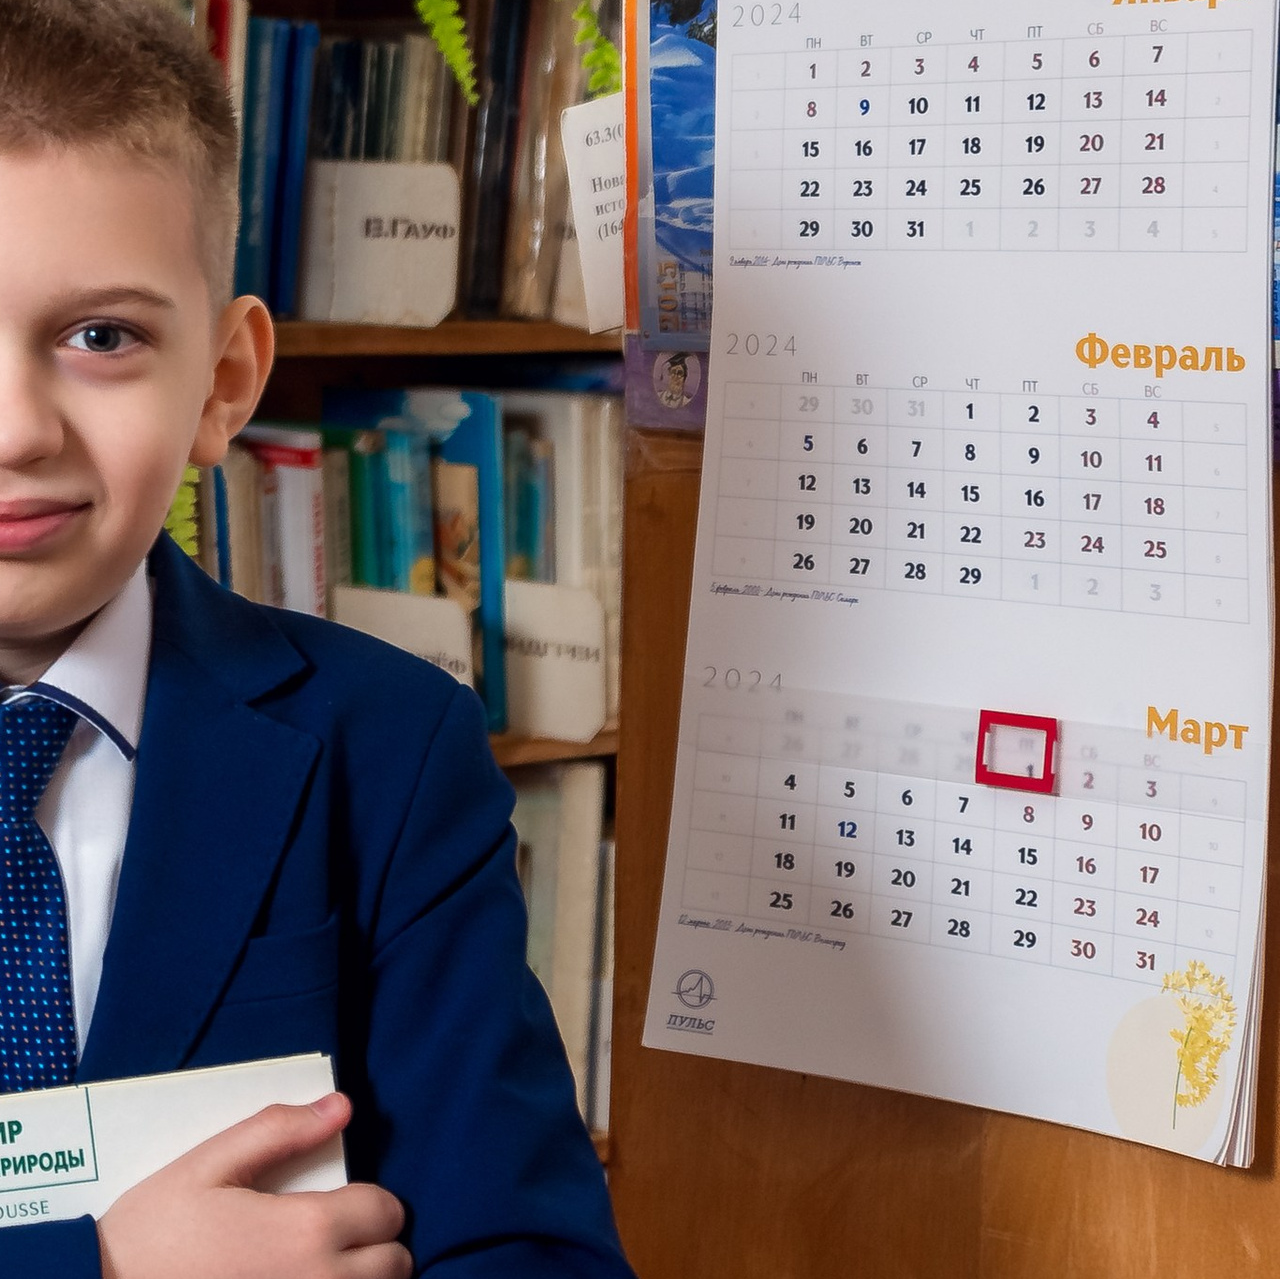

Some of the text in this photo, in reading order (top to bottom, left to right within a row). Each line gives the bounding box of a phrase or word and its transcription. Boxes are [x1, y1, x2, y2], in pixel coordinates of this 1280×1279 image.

[731, 2, 804, 28] 2024
[805, 18, 1168, 49] ПН ВТ СР ЧТ ПТ СБ ВС
[809, 45, 1164, 80] 1 2 3 4 5 6 7
[806, 89, 1168, 118] 8 9 10 11 12 13 14
[802, 132, 1165, 158] 15 16 17 18 19 20 21
[800, 176, 1166, 198] 22 23 24 25 26 27 28
[799, 220, 925, 238] 29 30 31
[657, 261, 681, 334] 2015
[726, 332, 798, 357] 2024
[1075, 332, 1247, 378] Февраль
[965, 402, 1160, 429] 1 2 3 4
[802, 434, 1163, 472] 5 6 7 8 9 10 11
[798, 474, 1166, 516] 12 13 14 15 16 17 18
[796, 513, 1167, 559] 19 20 21 22 23 24 25
[792, 552, 982, 585] 26 27 28 29
[702, 665, 785, 694] 2024
[1146, 706, 1250, 755] Март
[783, 773, 1162, 842] 4 5 6 7 8 9 10
[778, 813, 1160, 885] 11 12 13 14 15 16 17
[774, 852, 1161, 928] 18 19 20 21 22 23 24
[769, 890, 1156, 971] 25 26 27 28 29 30 31
[667, 1014, 715, 1031] ПУЛЬС
